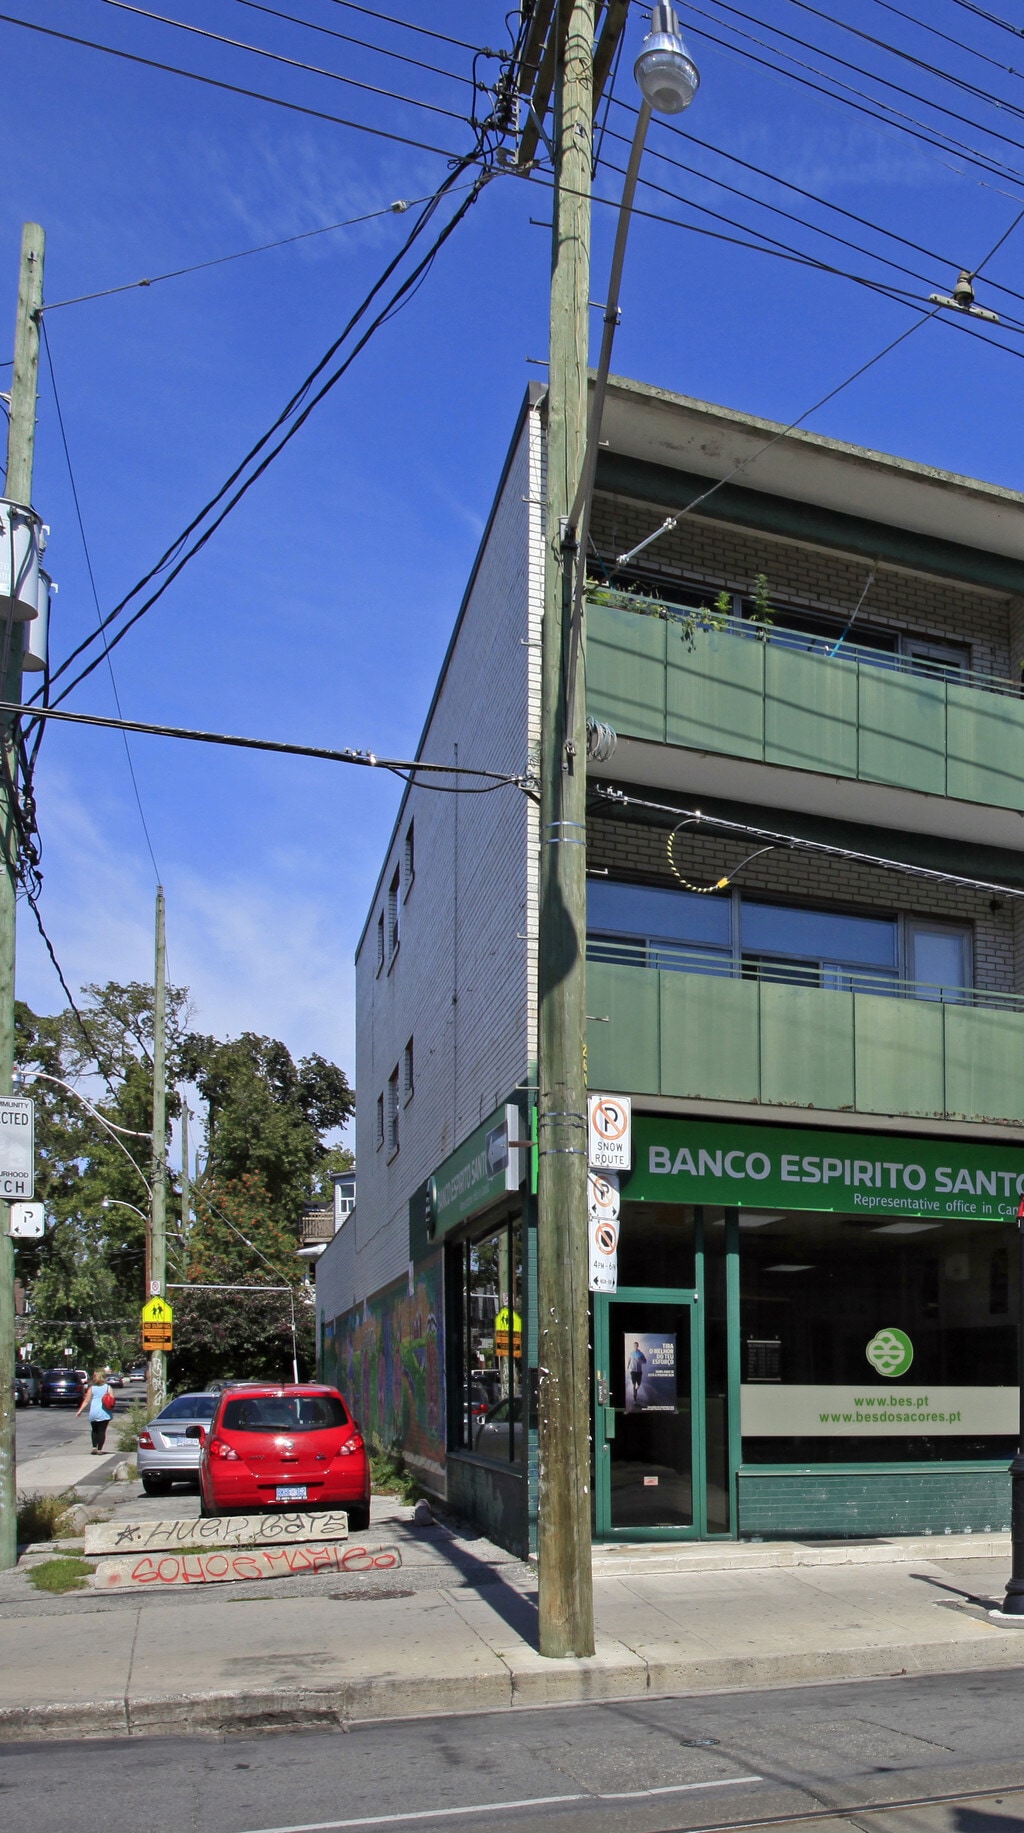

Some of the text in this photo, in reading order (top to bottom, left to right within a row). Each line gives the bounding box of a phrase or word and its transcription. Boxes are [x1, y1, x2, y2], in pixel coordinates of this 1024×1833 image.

[0, 1111, 29, 1125] CTED
[597, 1141, 623, 1152] SNOW
[595, 1153, 624, 1165] ROUTE
[649, 1146, 771, 1180] BANCO
[781, 1154, 926, 1191] ESPIRITO
[0, 1180, 25, 1194] CH
[854, 1193, 1019, 1216] Representative office in Can
[854, 1395, 929, 1409] www.bes.pt
[819, 1411, 961, 1424] www.besdosacores.pt
